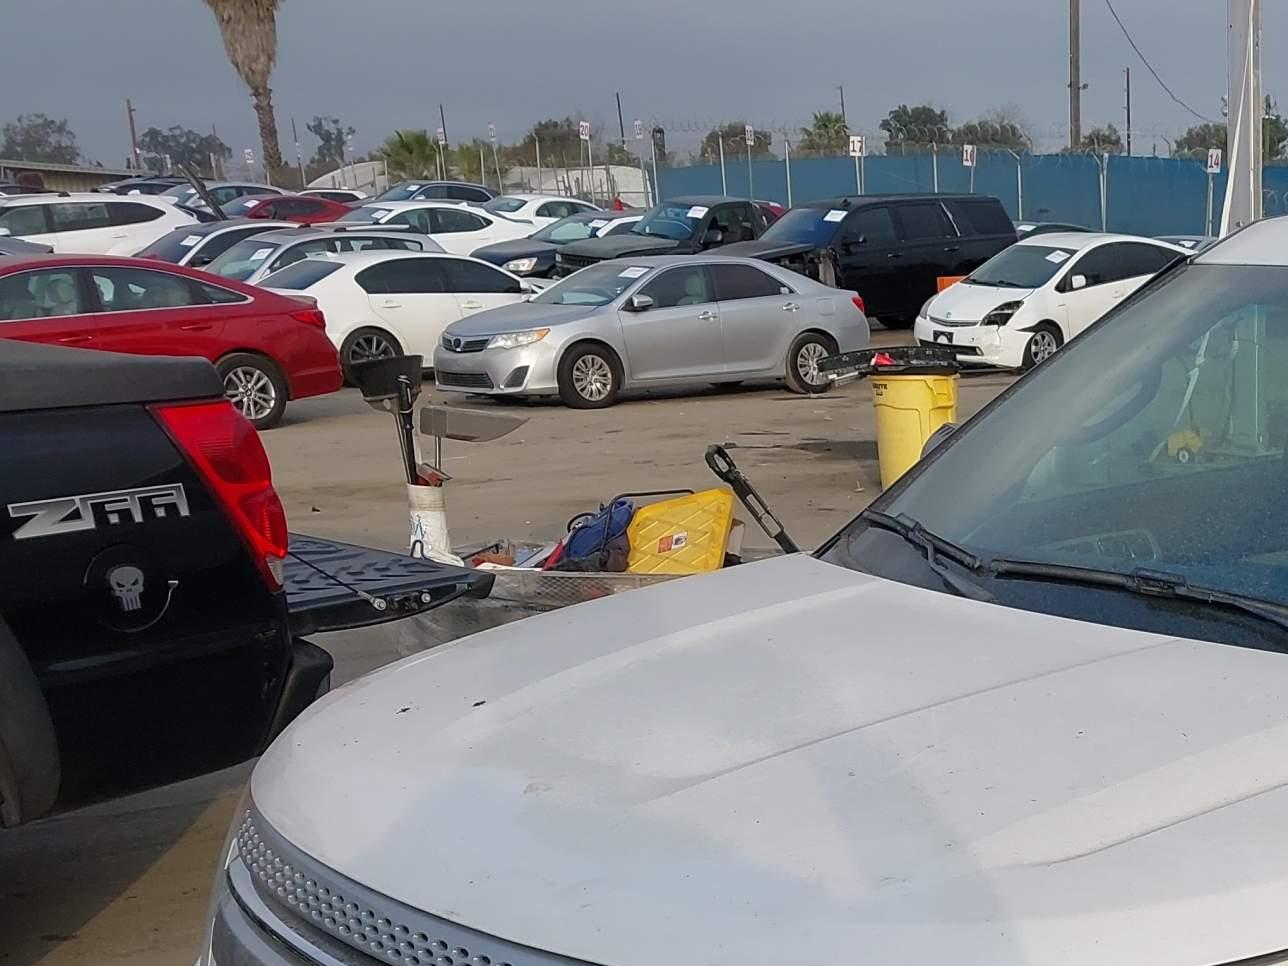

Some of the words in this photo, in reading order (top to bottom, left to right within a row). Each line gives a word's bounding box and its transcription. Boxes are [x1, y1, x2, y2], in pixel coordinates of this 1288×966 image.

[580, 124, 589, 137] 20
[850, 140, 863, 153] 17
[1208, 153, 1219, 168] 14
